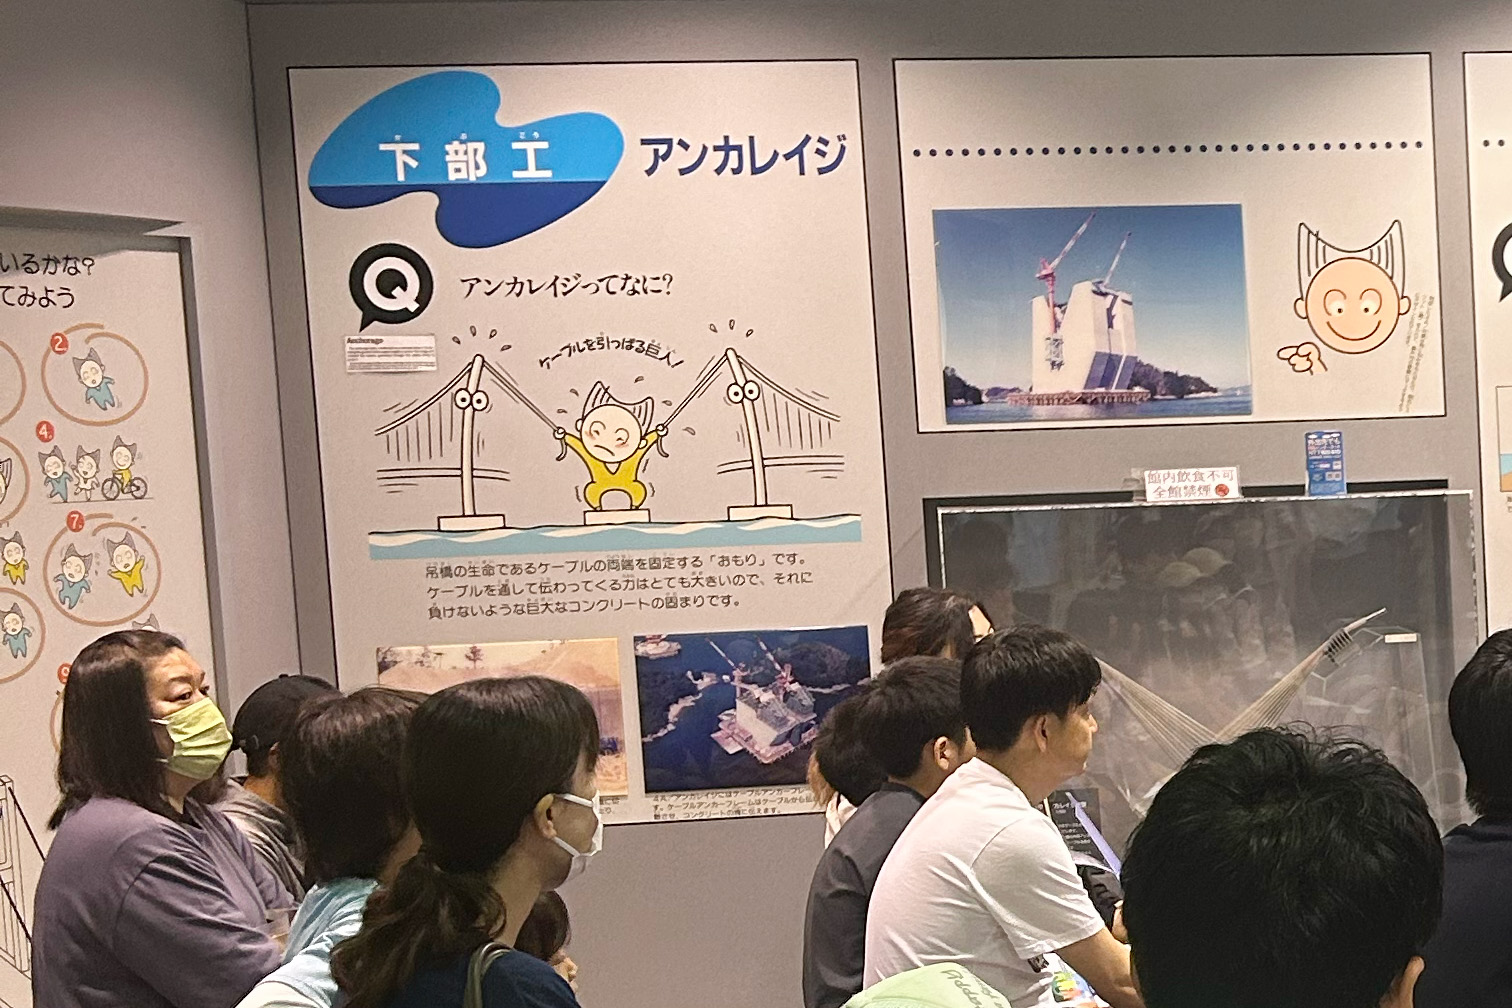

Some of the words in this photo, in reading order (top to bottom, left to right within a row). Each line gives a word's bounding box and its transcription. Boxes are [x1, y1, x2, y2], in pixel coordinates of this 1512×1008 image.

[640, 133, 847, 178] アンカレイジ
[0, 253, 96, 276] いるかな?
[0, 285, 76, 309] てみよう
[364, 255, 421, 313] Q
[459, 272, 674, 300] アンカレイジってなに?
